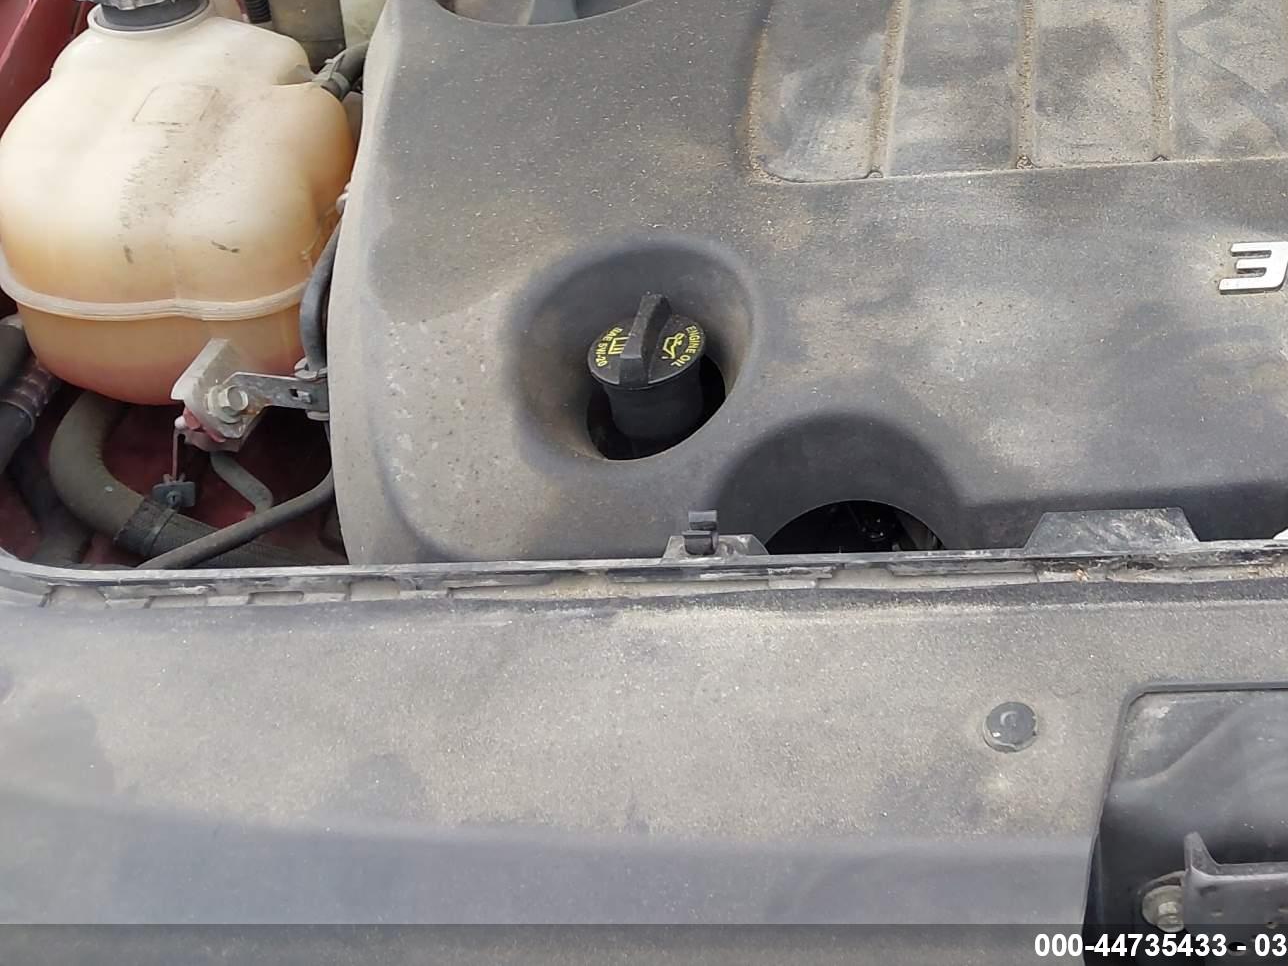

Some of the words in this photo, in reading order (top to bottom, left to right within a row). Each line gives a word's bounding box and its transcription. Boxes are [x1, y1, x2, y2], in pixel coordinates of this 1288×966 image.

[686, 325, 700, 354] ENGINE
[594, 343, 609, 367] 5W-20
[671, 355, 692, 368] OIL
